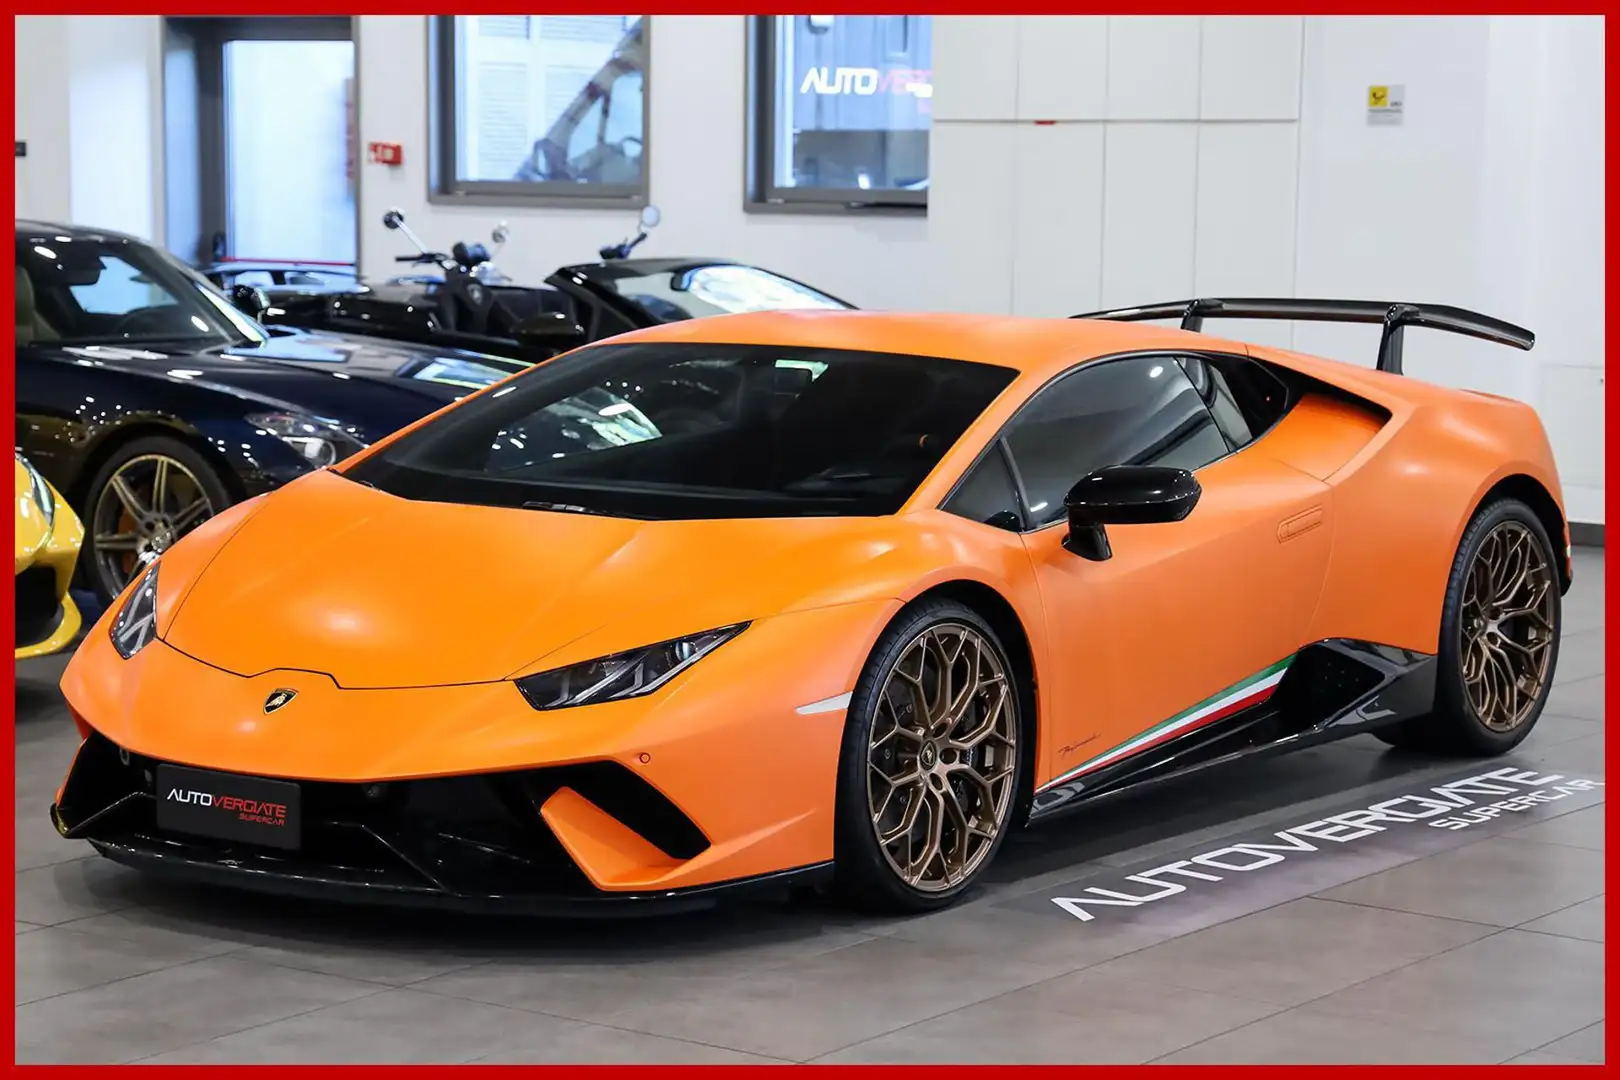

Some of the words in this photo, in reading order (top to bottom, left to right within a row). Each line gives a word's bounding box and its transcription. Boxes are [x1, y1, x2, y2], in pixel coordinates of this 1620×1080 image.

[167, 788, 287, 818] AUTOVERGIATE
[239, 812, 285, 826] SUPERCAR
[1428, 779, 1605, 830] SUPERCAR
[1051, 767, 1565, 922] AUTOVERGIATE
